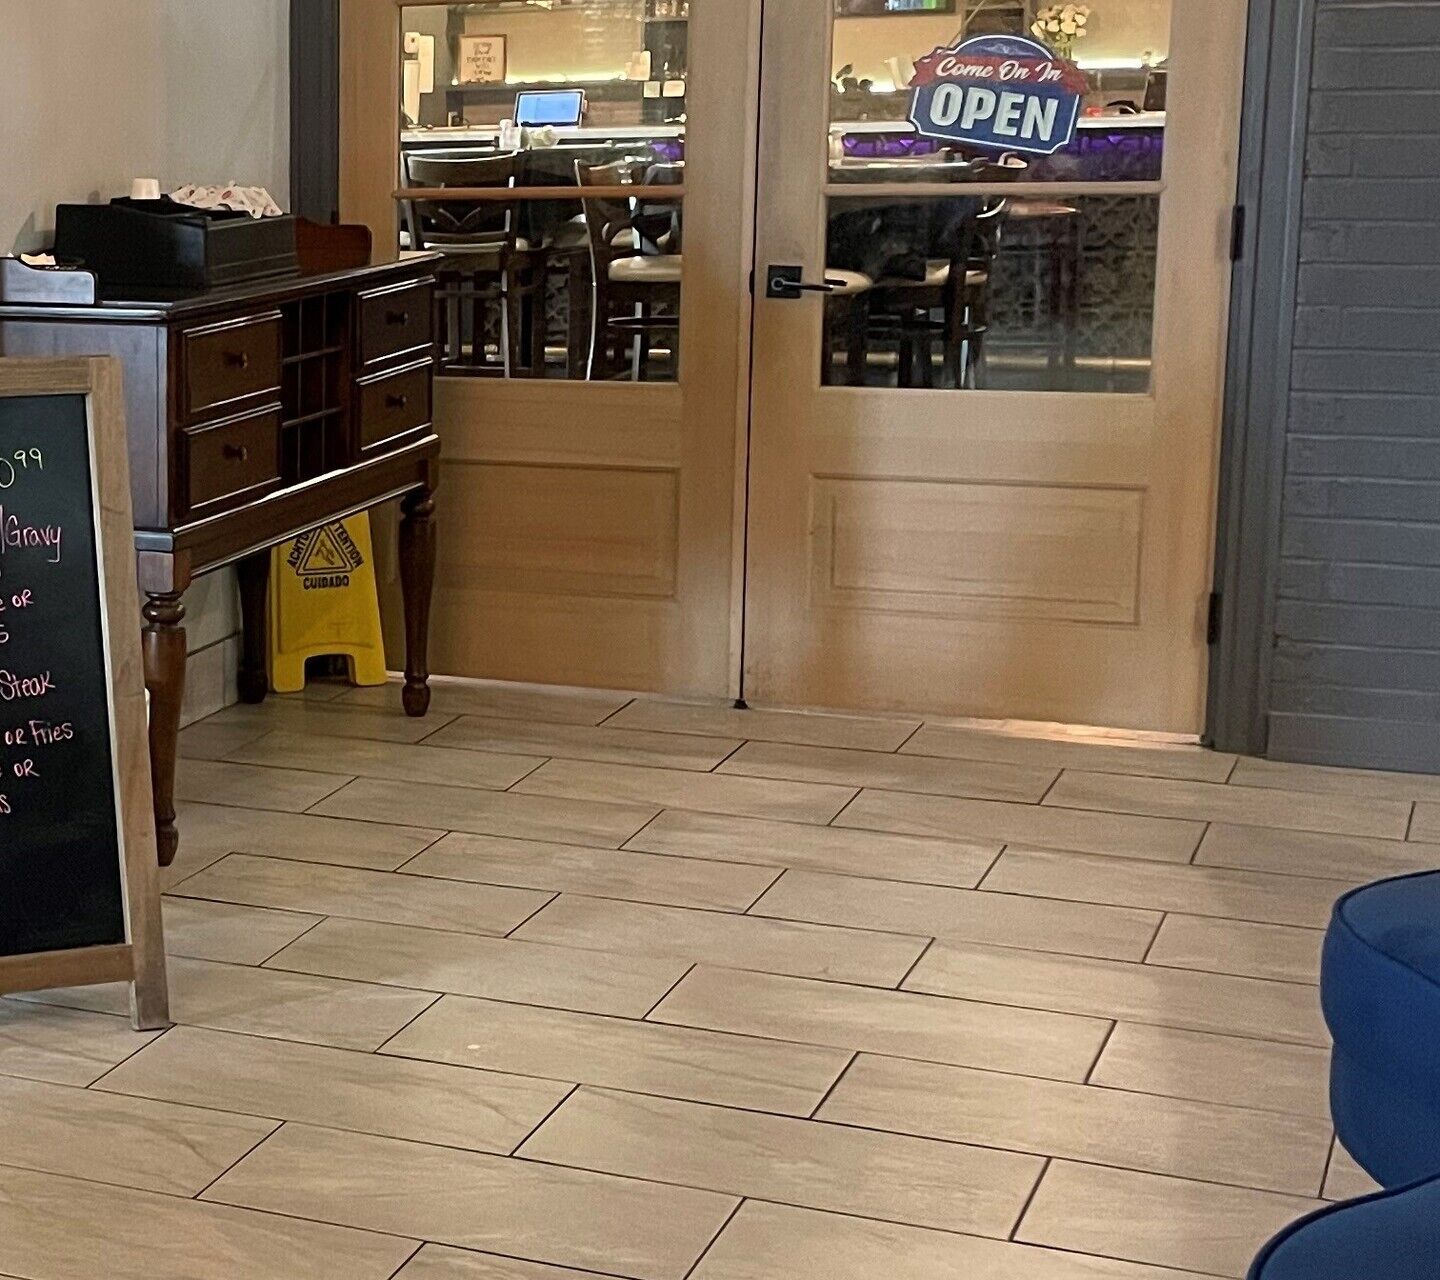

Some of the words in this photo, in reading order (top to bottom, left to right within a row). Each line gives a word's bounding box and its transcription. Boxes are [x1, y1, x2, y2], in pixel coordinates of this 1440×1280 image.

[935, 56, 993, 78] Come
[999, 59, 1031, 81] On
[1035, 61, 1064, 83] In
[929, 82, 1059, 142] OPEN
[303, 574, 350, 591] CUIDADO
[28, 719, 74, 747] Fries
